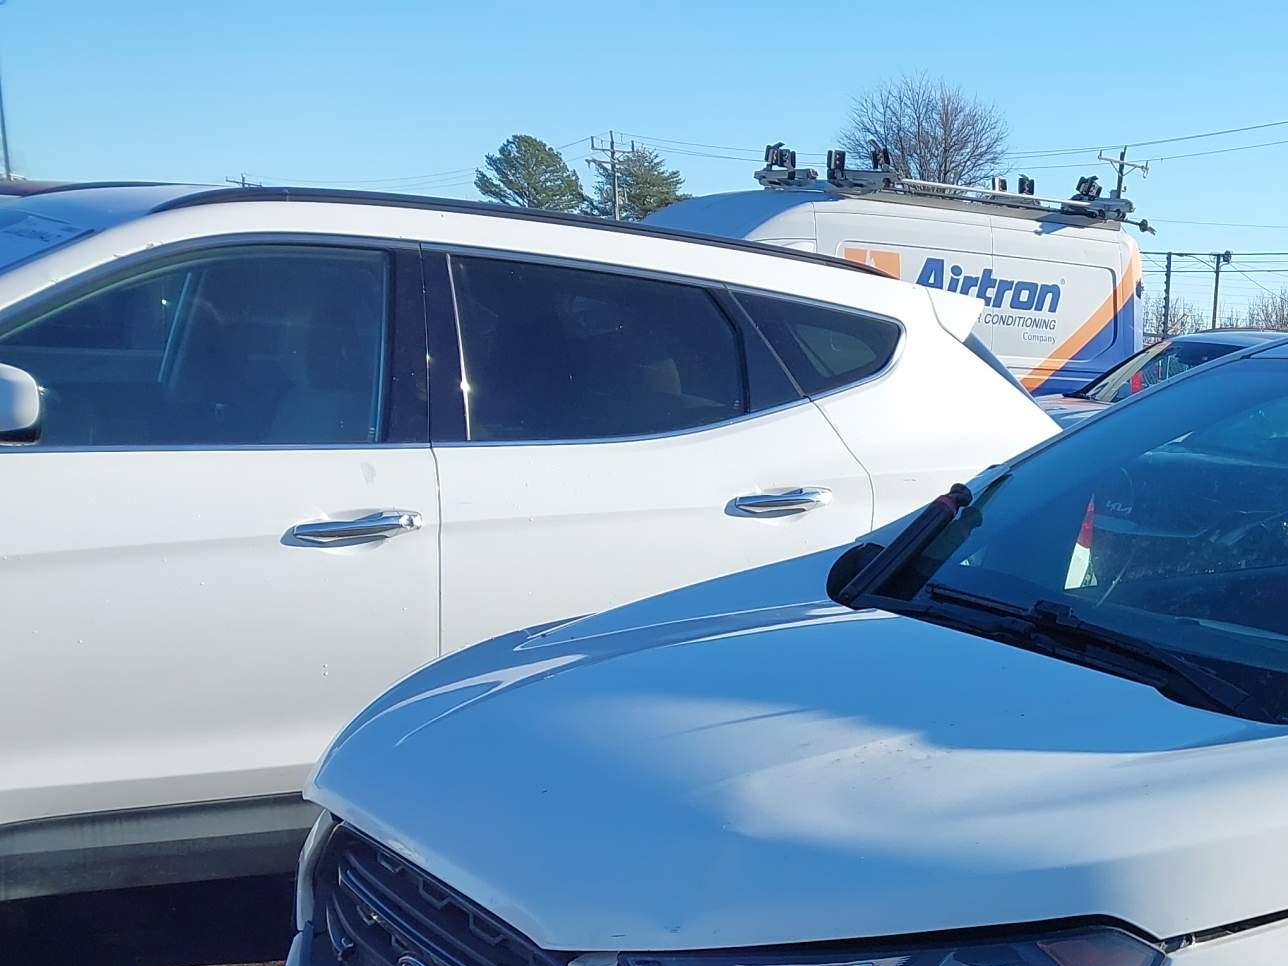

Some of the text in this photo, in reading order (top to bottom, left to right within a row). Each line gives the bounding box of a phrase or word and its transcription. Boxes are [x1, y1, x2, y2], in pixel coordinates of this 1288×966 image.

[914, 257, 1061, 313] Airtron
[983, 312, 1057, 331] CONDITIONING
[1022, 331, 1057, 345] Company
